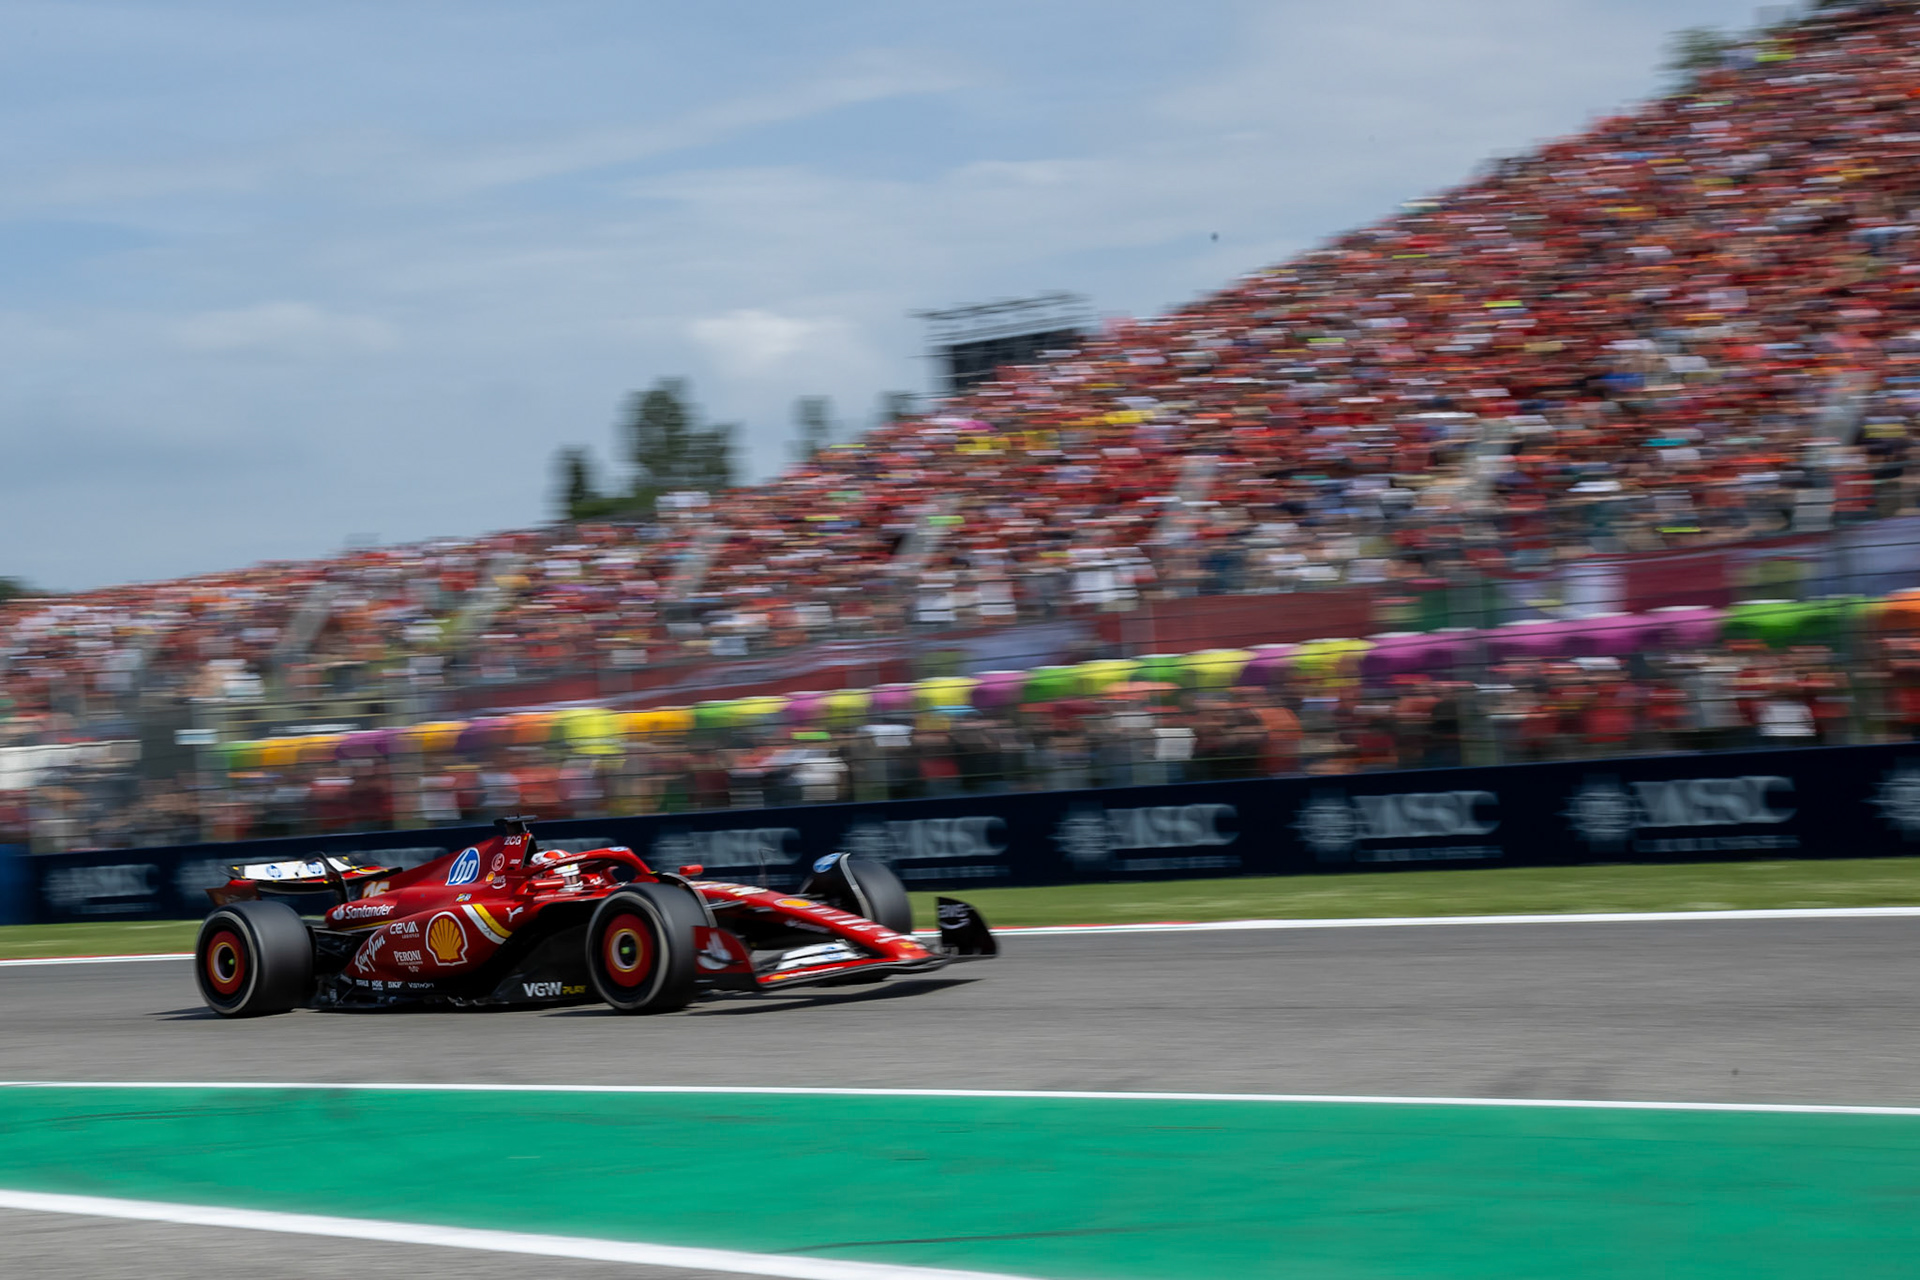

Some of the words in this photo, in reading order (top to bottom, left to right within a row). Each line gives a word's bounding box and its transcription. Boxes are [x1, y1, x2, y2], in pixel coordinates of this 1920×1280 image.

[450, 848, 478, 885] hp
[345, 904, 395, 919] Santander
[393, 950, 422, 962] PERONI
[522, 981, 563, 997] VGW
